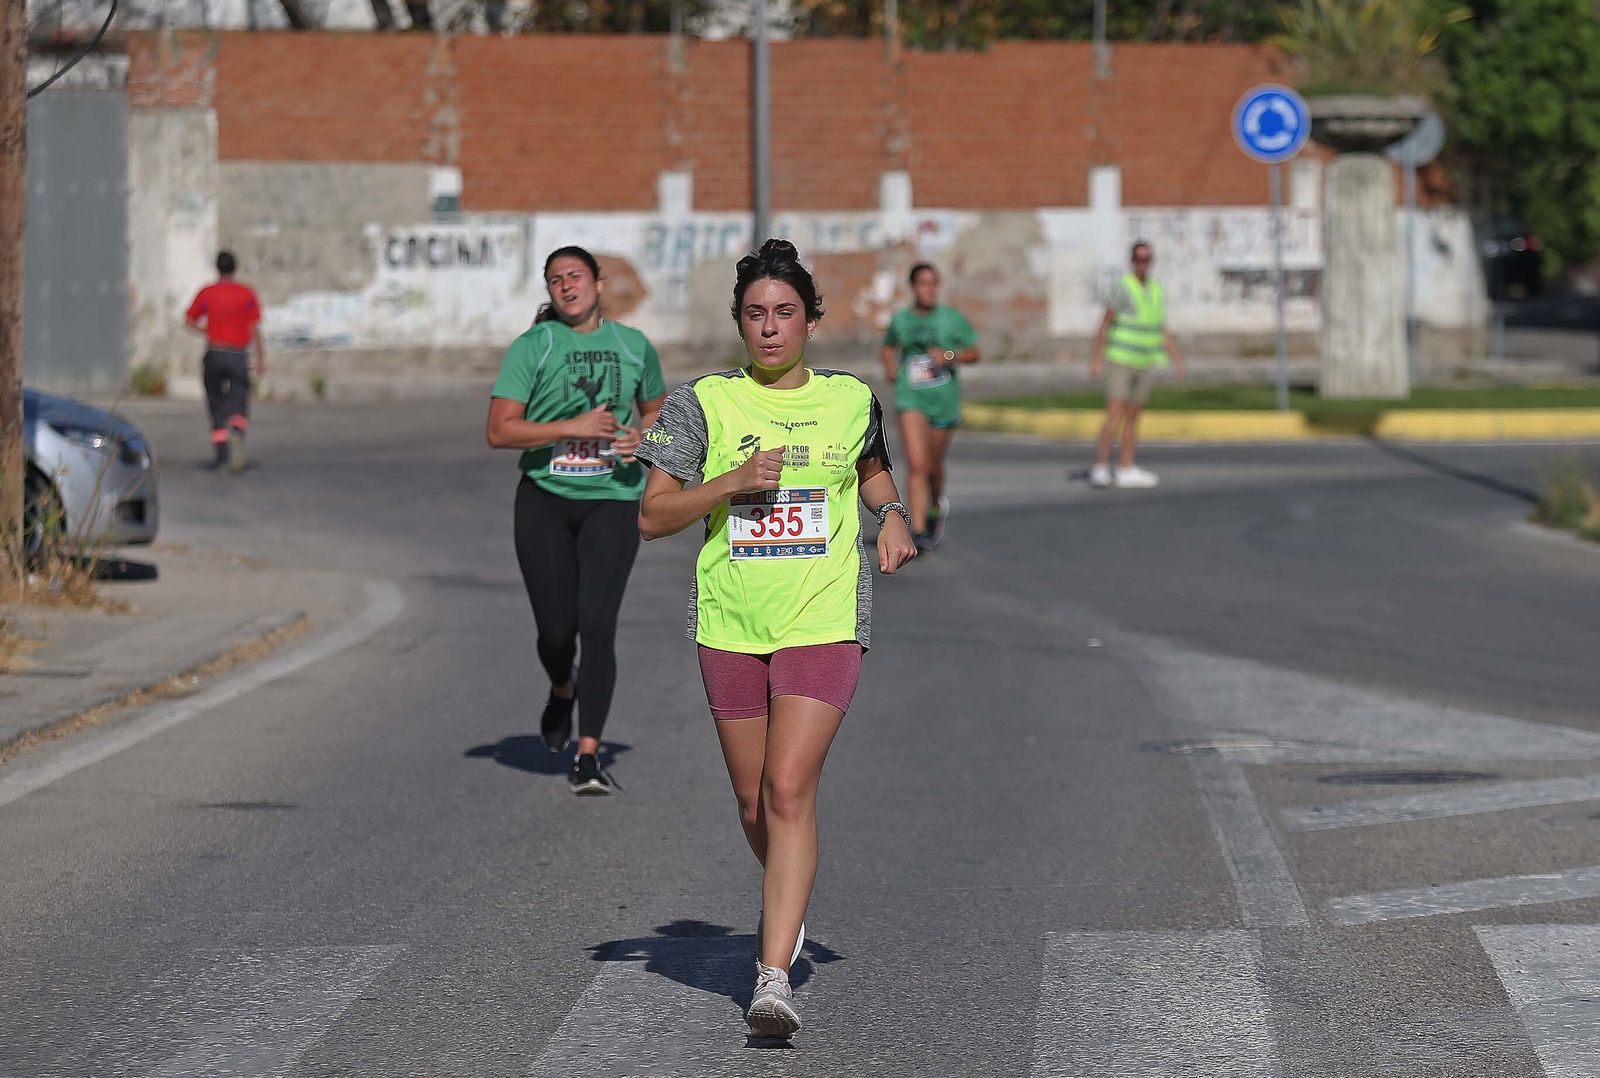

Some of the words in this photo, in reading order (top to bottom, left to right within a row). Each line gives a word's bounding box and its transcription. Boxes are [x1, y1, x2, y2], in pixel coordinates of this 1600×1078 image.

[567, 441, 600, 461] 351
[792, 445, 810, 454] PEOR
[765, 490, 790, 503] CROSS
[750, 506, 804, 538] 355
